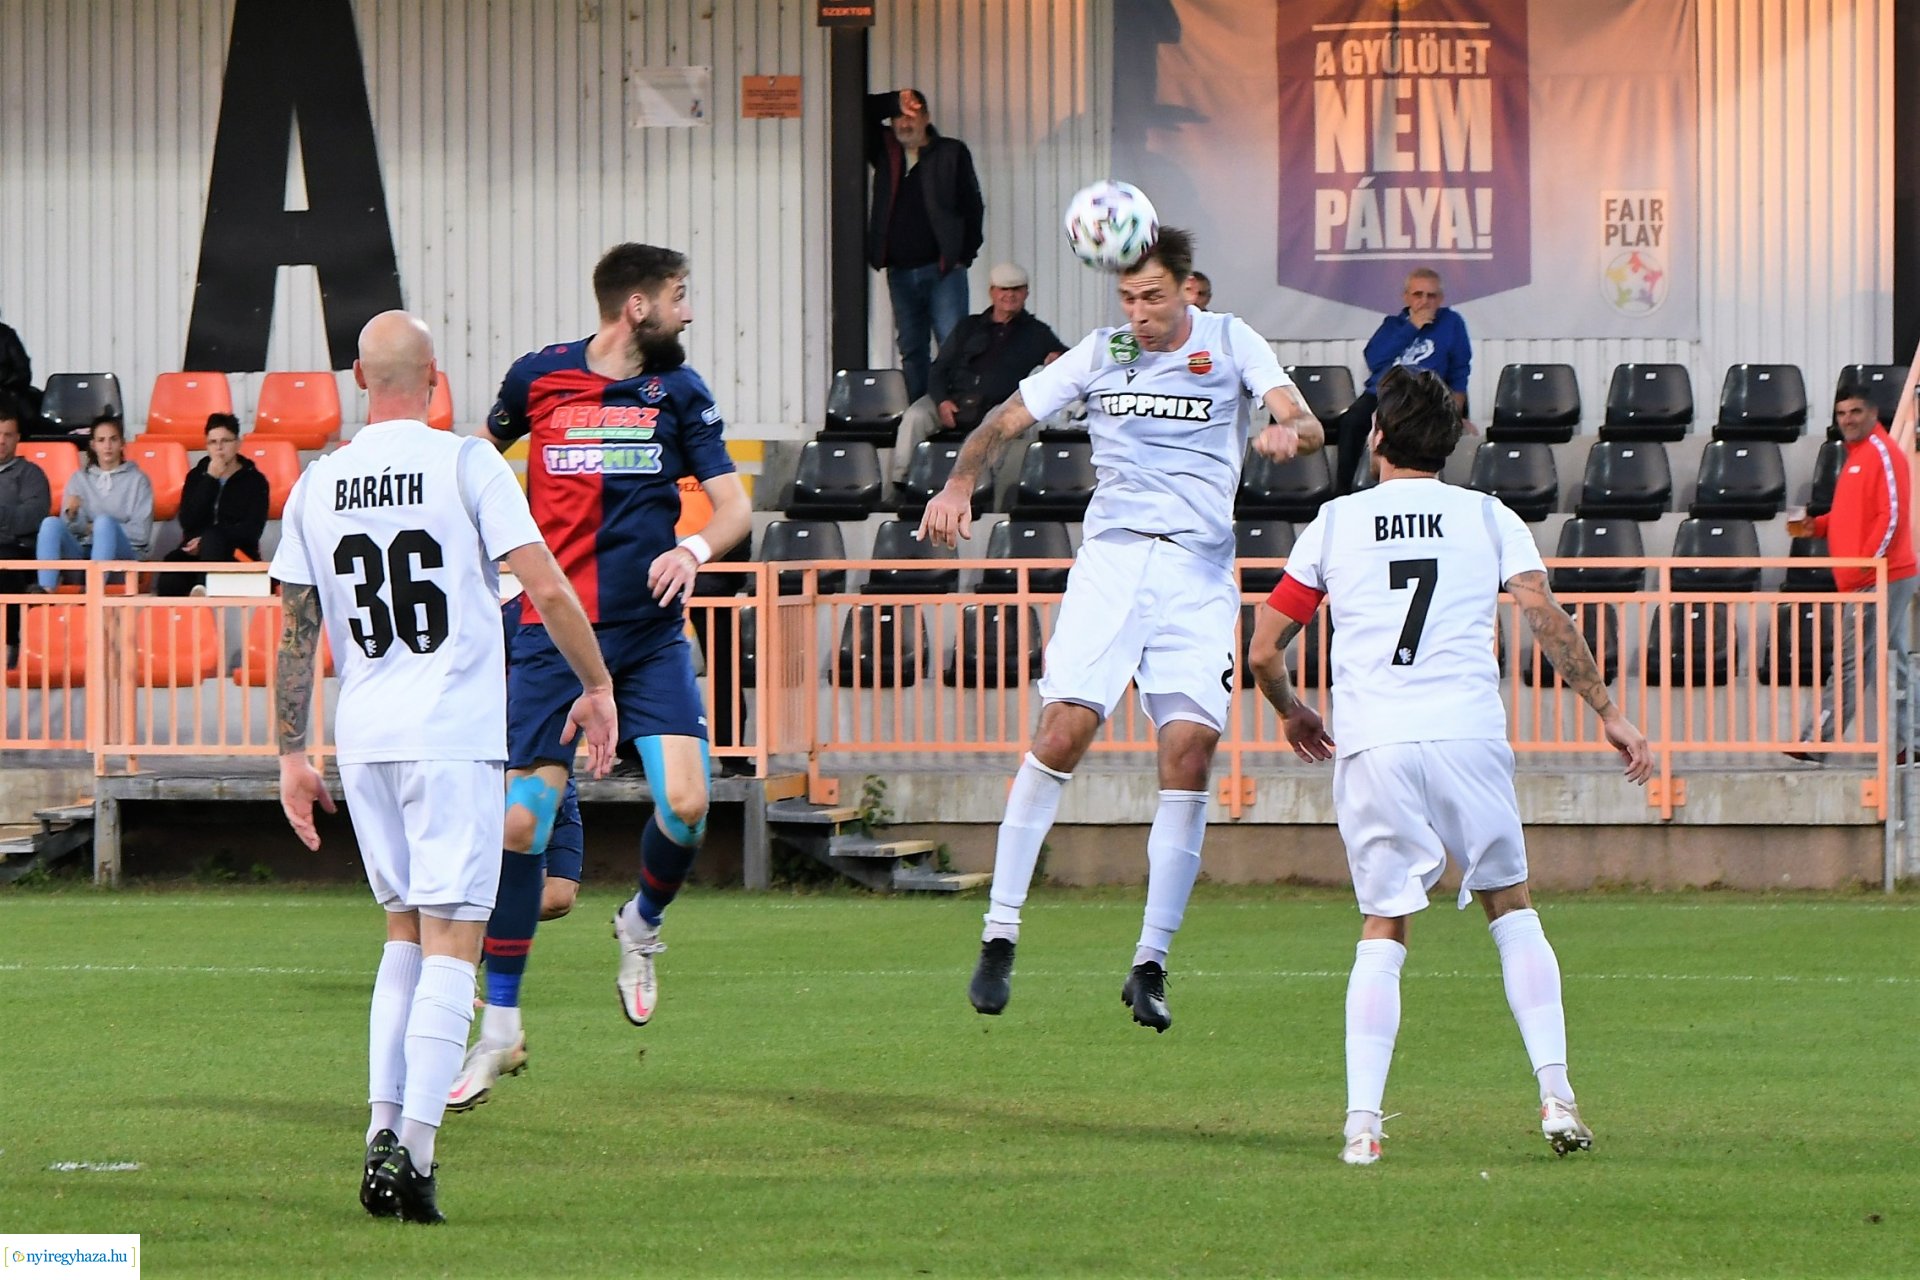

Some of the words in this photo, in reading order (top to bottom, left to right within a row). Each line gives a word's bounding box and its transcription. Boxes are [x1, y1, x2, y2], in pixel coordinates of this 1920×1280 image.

[1314, 41, 1336, 77] A
[1314, 78, 1493, 174] NEM
[183, 0, 405, 373] A
[1314, 176, 1493, 250] PÁLYA!
[1605, 198, 1663, 221] FAIR
[1605, 224, 1663, 247] PLAY
[334, 466, 424, 511] BARÁTH
[1375, 513, 1444, 542] BATIK
[333, 529, 449, 659] 36
[1389, 558, 1438, 666] 7
